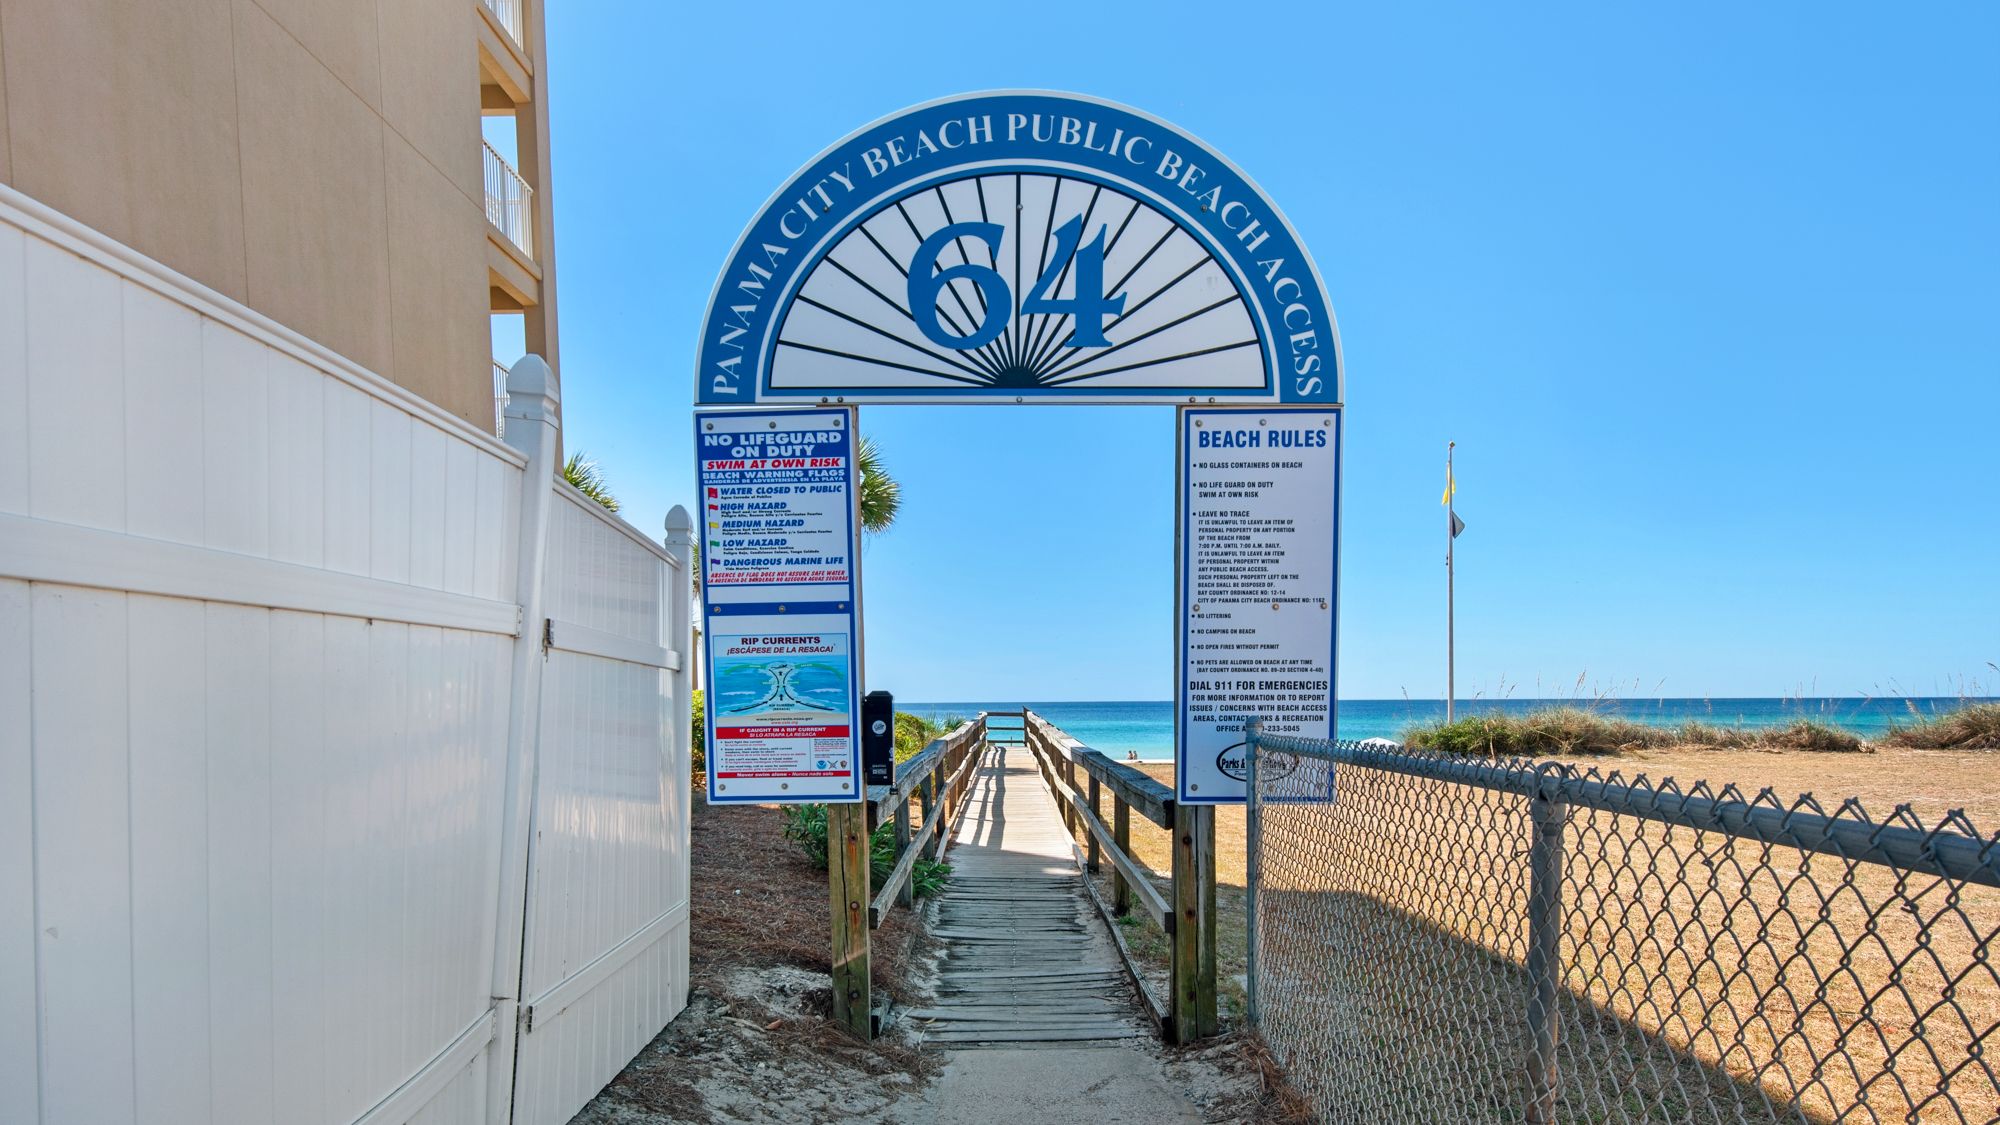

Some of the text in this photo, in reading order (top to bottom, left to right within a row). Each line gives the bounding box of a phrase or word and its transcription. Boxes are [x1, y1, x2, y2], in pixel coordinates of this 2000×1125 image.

[713, 114, 1322, 396] PANAMA CITY BEACH PUBLIC BEACH ACCESS
[907, 213, 1128, 350] 64
[705, 433, 841, 446] NO LIFEGUARD
[1199, 430, 1326, 448] BEACH RULES
[732, 446, 814, 457] ON DUTY
[707, 458, 840, 469] SWIM AT OWN RISK
[1190, 681, 1327, 690] DIAL 911 FOR EMERGENCIES
[1222, 758, 1240, 768] Parks
